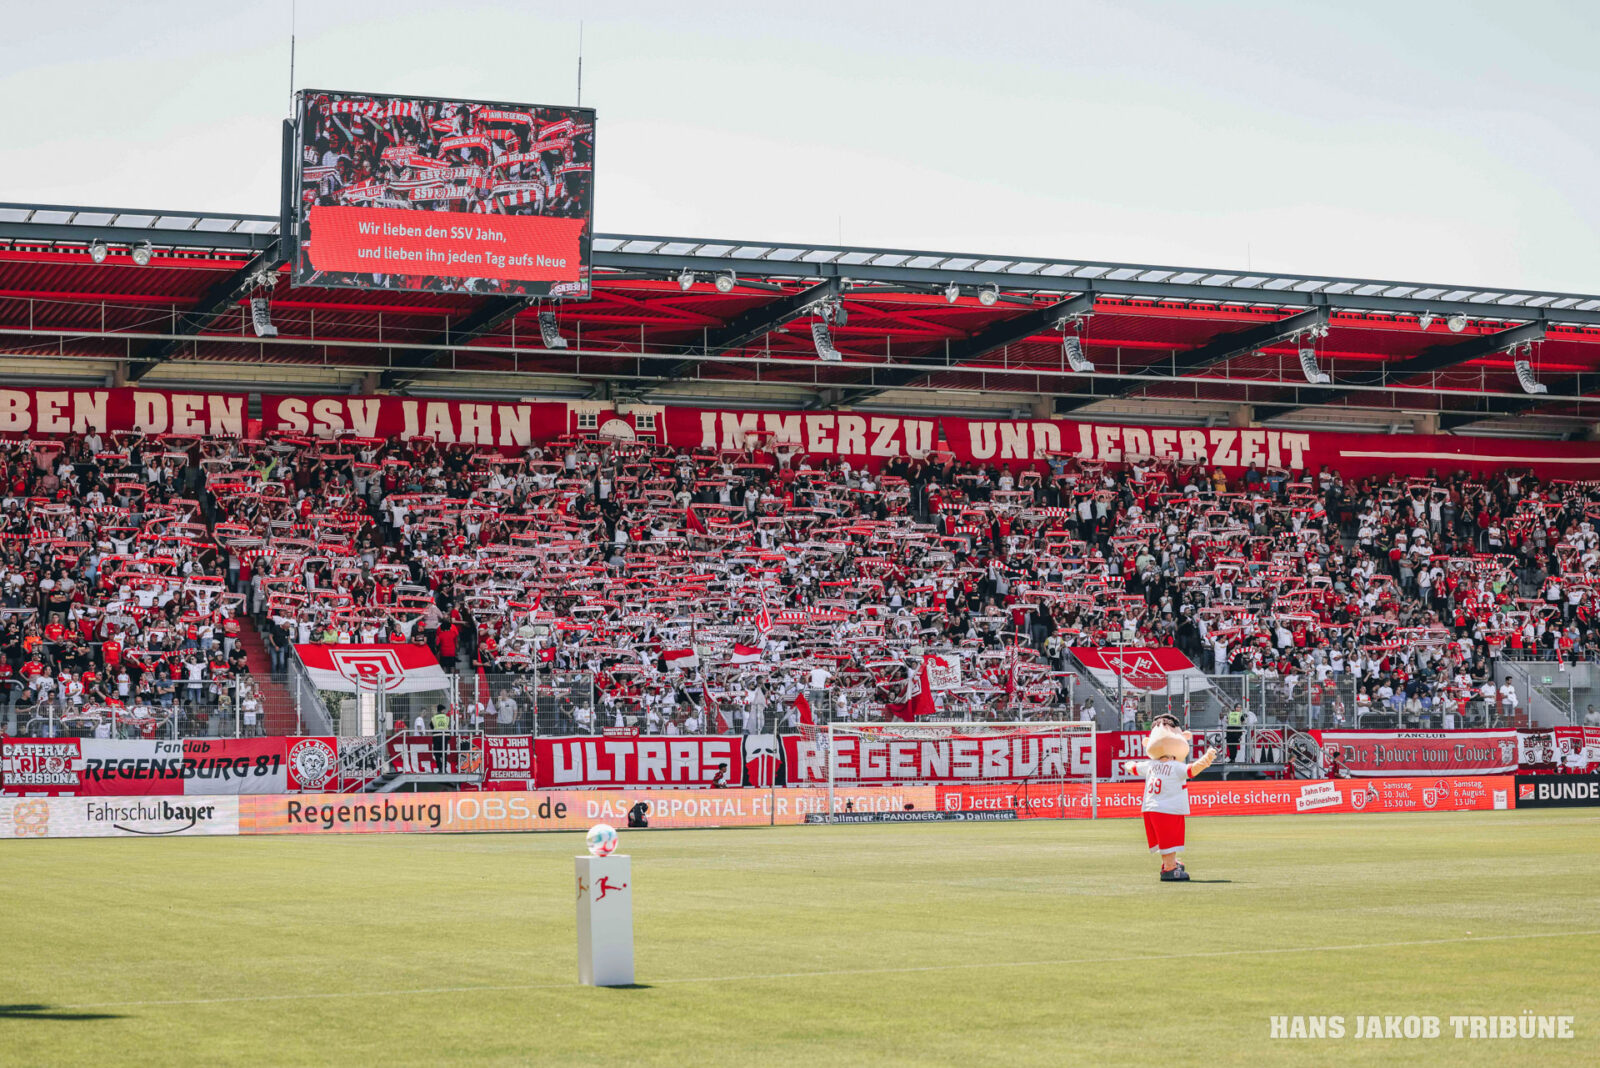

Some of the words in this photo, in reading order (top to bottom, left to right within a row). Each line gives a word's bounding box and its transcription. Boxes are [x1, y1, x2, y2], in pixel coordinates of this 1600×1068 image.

[414, 188, 433, 199] SSV
[446, 187, 471, 199] JAHN
[359, 222, 381, 236] Wir
[383, 223, 422, 238] lieben
[425, 226, 447, 239] den
[450, 227, 473, 240] SSV
[476, 228, 507, 243] Jahn,
[358, 246, 381, 259] und
[384, 247, 422, 261] lieben
[425, 249, 445, 262] ihn
[447, 250, 482, 265] jeden
[484, 252, 505, 268] Tag
[508, 253, 533, 267] aufs
[536, 254, 566, 269] Neue
[0, 389, 109, 434] BEN
[133, 391, 244, 436] DEN
[276, 398, 381, 439] SSV
[400, 400, 532, 446] JAHN
[700, 412, 934, 460] IMMERZU
[969, 422, 1061, 459] UND
[1077, 424, 1311, 469] JEDERZEIT
[155, 741, 211, 754] Fanclub
[488, 738, 504, 747] SSV
[506, 738, 528, 747] JAHN
[3, 743, 79, 757] CATERVA
[1342, 744, 1368, 763] Die
[1373, 744, 1418, 766] Power
[1421, 744, 1448, 763] vom
[1454, 744, 1496, 763] Tower
[490, 748, 531, 769] 1889
[552, 741, 731, 784] ULTRAS
[797, 736, 1093, 780] REGENSBURG
[85, 756, 250, 782] REGENSBURG
[254, 754, 281, 776] 81
[490, 770, 532, 779] REGENSBURG
[4, 772, 80, 785] RATISBONA
[1454, 780, 1484, 789] Samstag,
[1304, 788, 1318, 796] Jahn
[1383, 782, 1413, 791] Samstag,
[1539, 782, 1600, 800] BUNDE
[969, 795, 1002, 809] Jetzt
[1005, 795, 1054, 808] Tickets
[1057, 794, 1077, 808] für
[1080, 793, 1101, 807] die
[1105, 790, 1143, 807] nächs
[1189, 790, 1241, 809] mspiele
[1243, 789, 1291, 804] sichern
[1396, 790, 1410, 799] Juli,
[1454, 789, 1461, 797] 6.
[1462, 789, 1487, 799] August,
[587, 799, 627, 819] DAS
[646, 797, 746, 817] OBPORTAL
[752, 794, 788, 816] FÜR
[795, 797, 825, 815] DIE
[833, 795, 904, 812] REGION
[1306, 796, 1339, 806] Onlineshop
[1384, 800, 1403, 808] 15.30
[1405, 800, 1416, 808] Uhr
[1455, 798, 1463, 806] 13
[1465, 798, 1476, 806] Uhr
[966, 811, 1014, 821] Dallmeier
